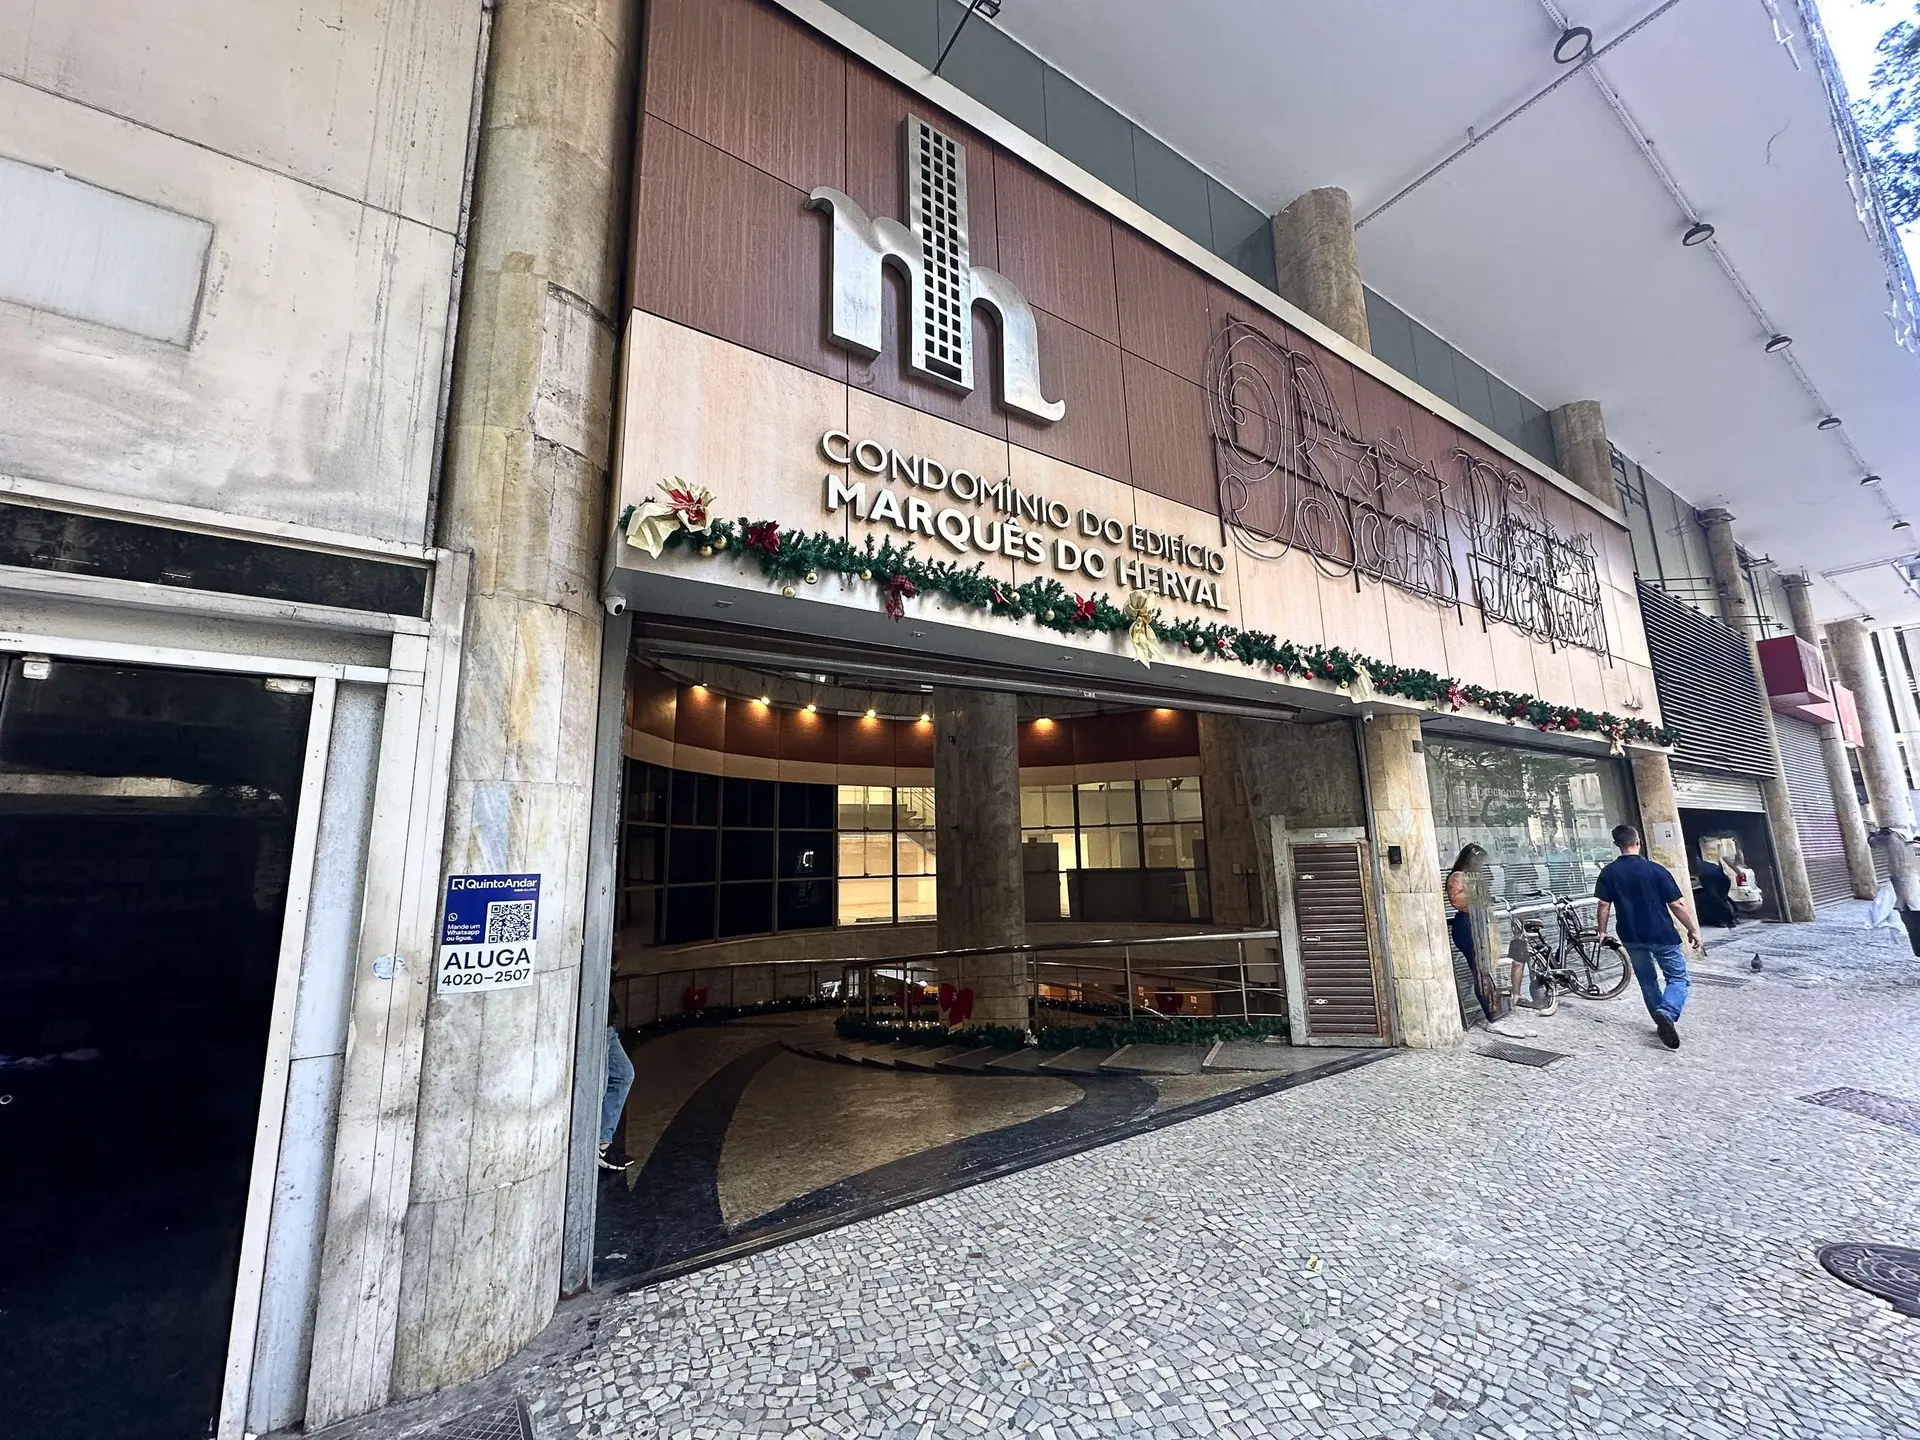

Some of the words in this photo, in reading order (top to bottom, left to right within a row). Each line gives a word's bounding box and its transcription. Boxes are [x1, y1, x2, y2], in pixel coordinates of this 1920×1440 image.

[820, 428, 1072, 530] CONDOMÍNIO
[1079, 508, 1125, 545] DO
[1131, 523, 1227, 575] EDIFÍCIO
[826, 473, 1047, 565] MARQUÊS
[1054, 537, 1110, 579] DO
[1116, 555, 1231, 612] HERVAL
[466, 878, 538, 889] QuintoAndar
[443, 948, 531, 970] ALUGA
[442, 968, 530, 986] 4020-2507
